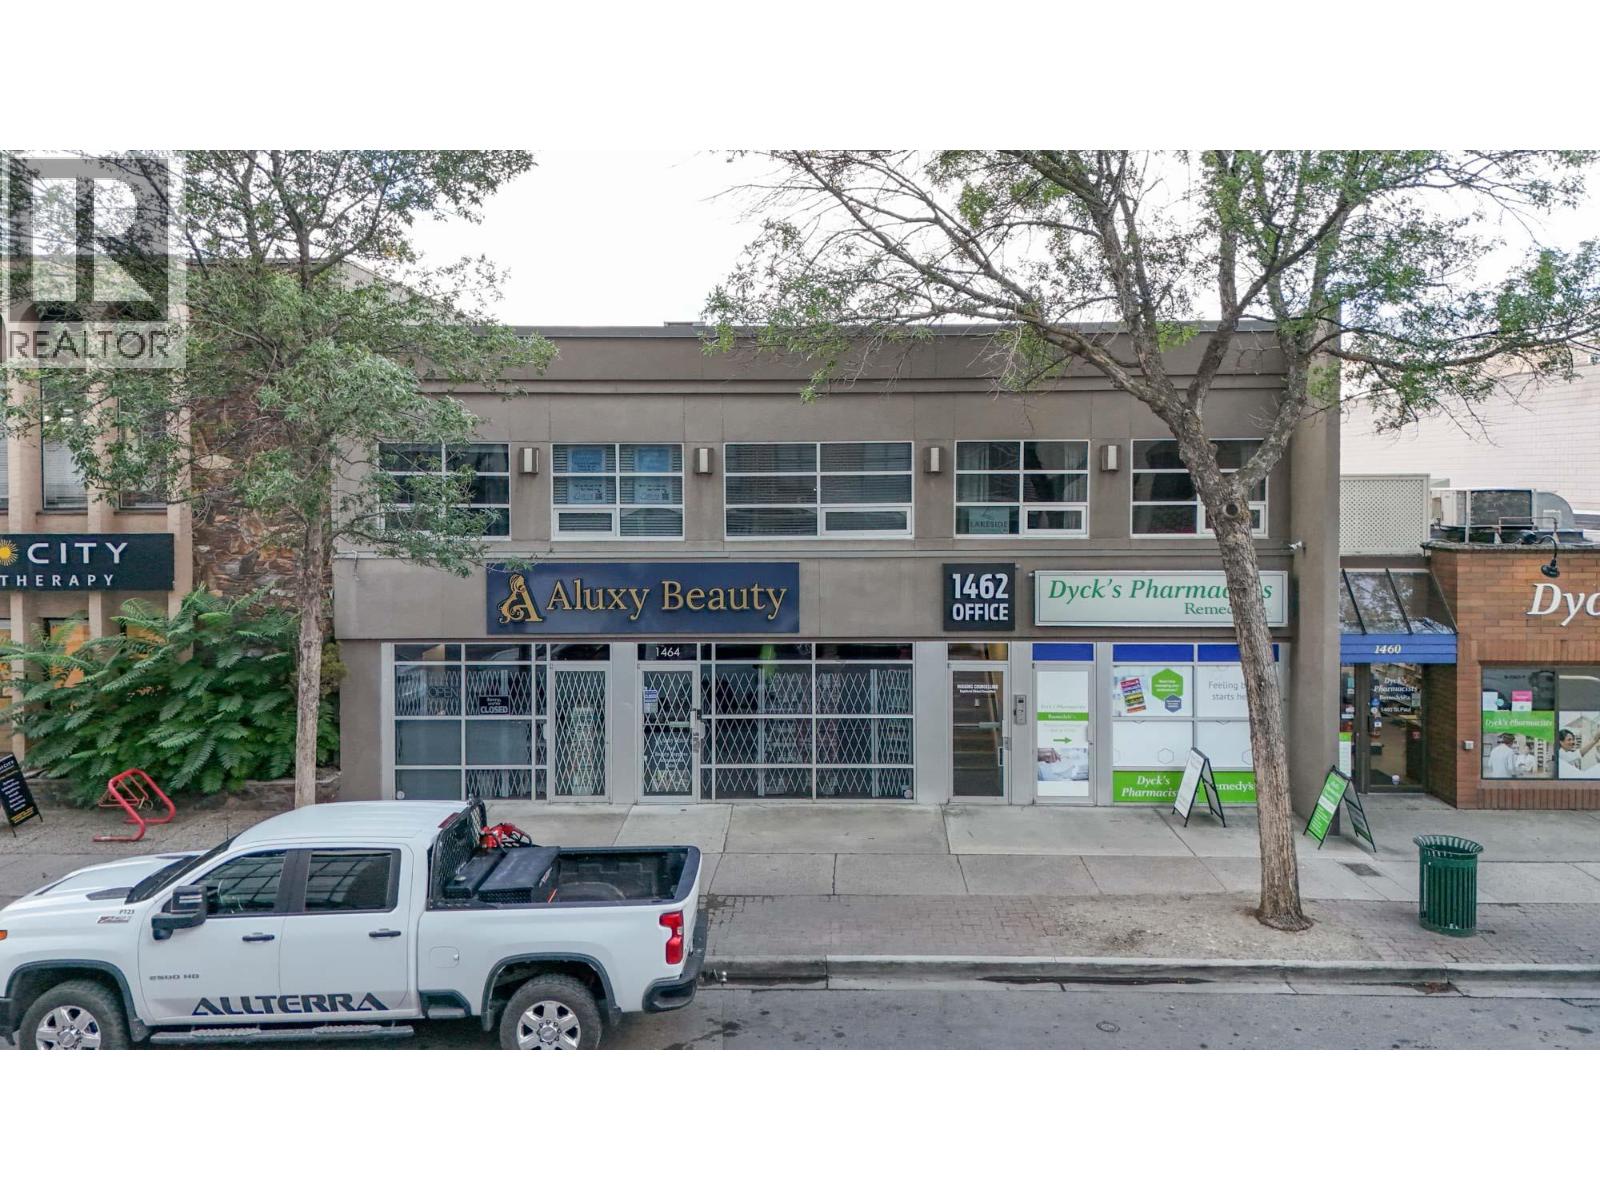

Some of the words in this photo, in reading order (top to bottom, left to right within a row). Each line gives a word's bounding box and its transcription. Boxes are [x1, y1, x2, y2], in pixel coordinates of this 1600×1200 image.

[27, 542, 129, 564] CITY
[952, 573, 1009, 599] 1462
[1047, 578, 1122, 605] Dyck's
[547, 578, 650, 621] Aluxy
[661, 580, 788, 621] Beauty
[952, 603, 1009, 621] OFFICE
[655, 647, 681, 657] 1464
[1374, 644, 1402, 654] 1460
[1208, 680, 1239, 690] Feeling
[428, 687, 460, 698] OPEN
[1211, 693, 1234, 701] starts
[480, 705, 509, 714] CLOSED
[1136, 775, 1170, 788] Dyck's
[191, 991, 390, 1016] ALLTERRA
